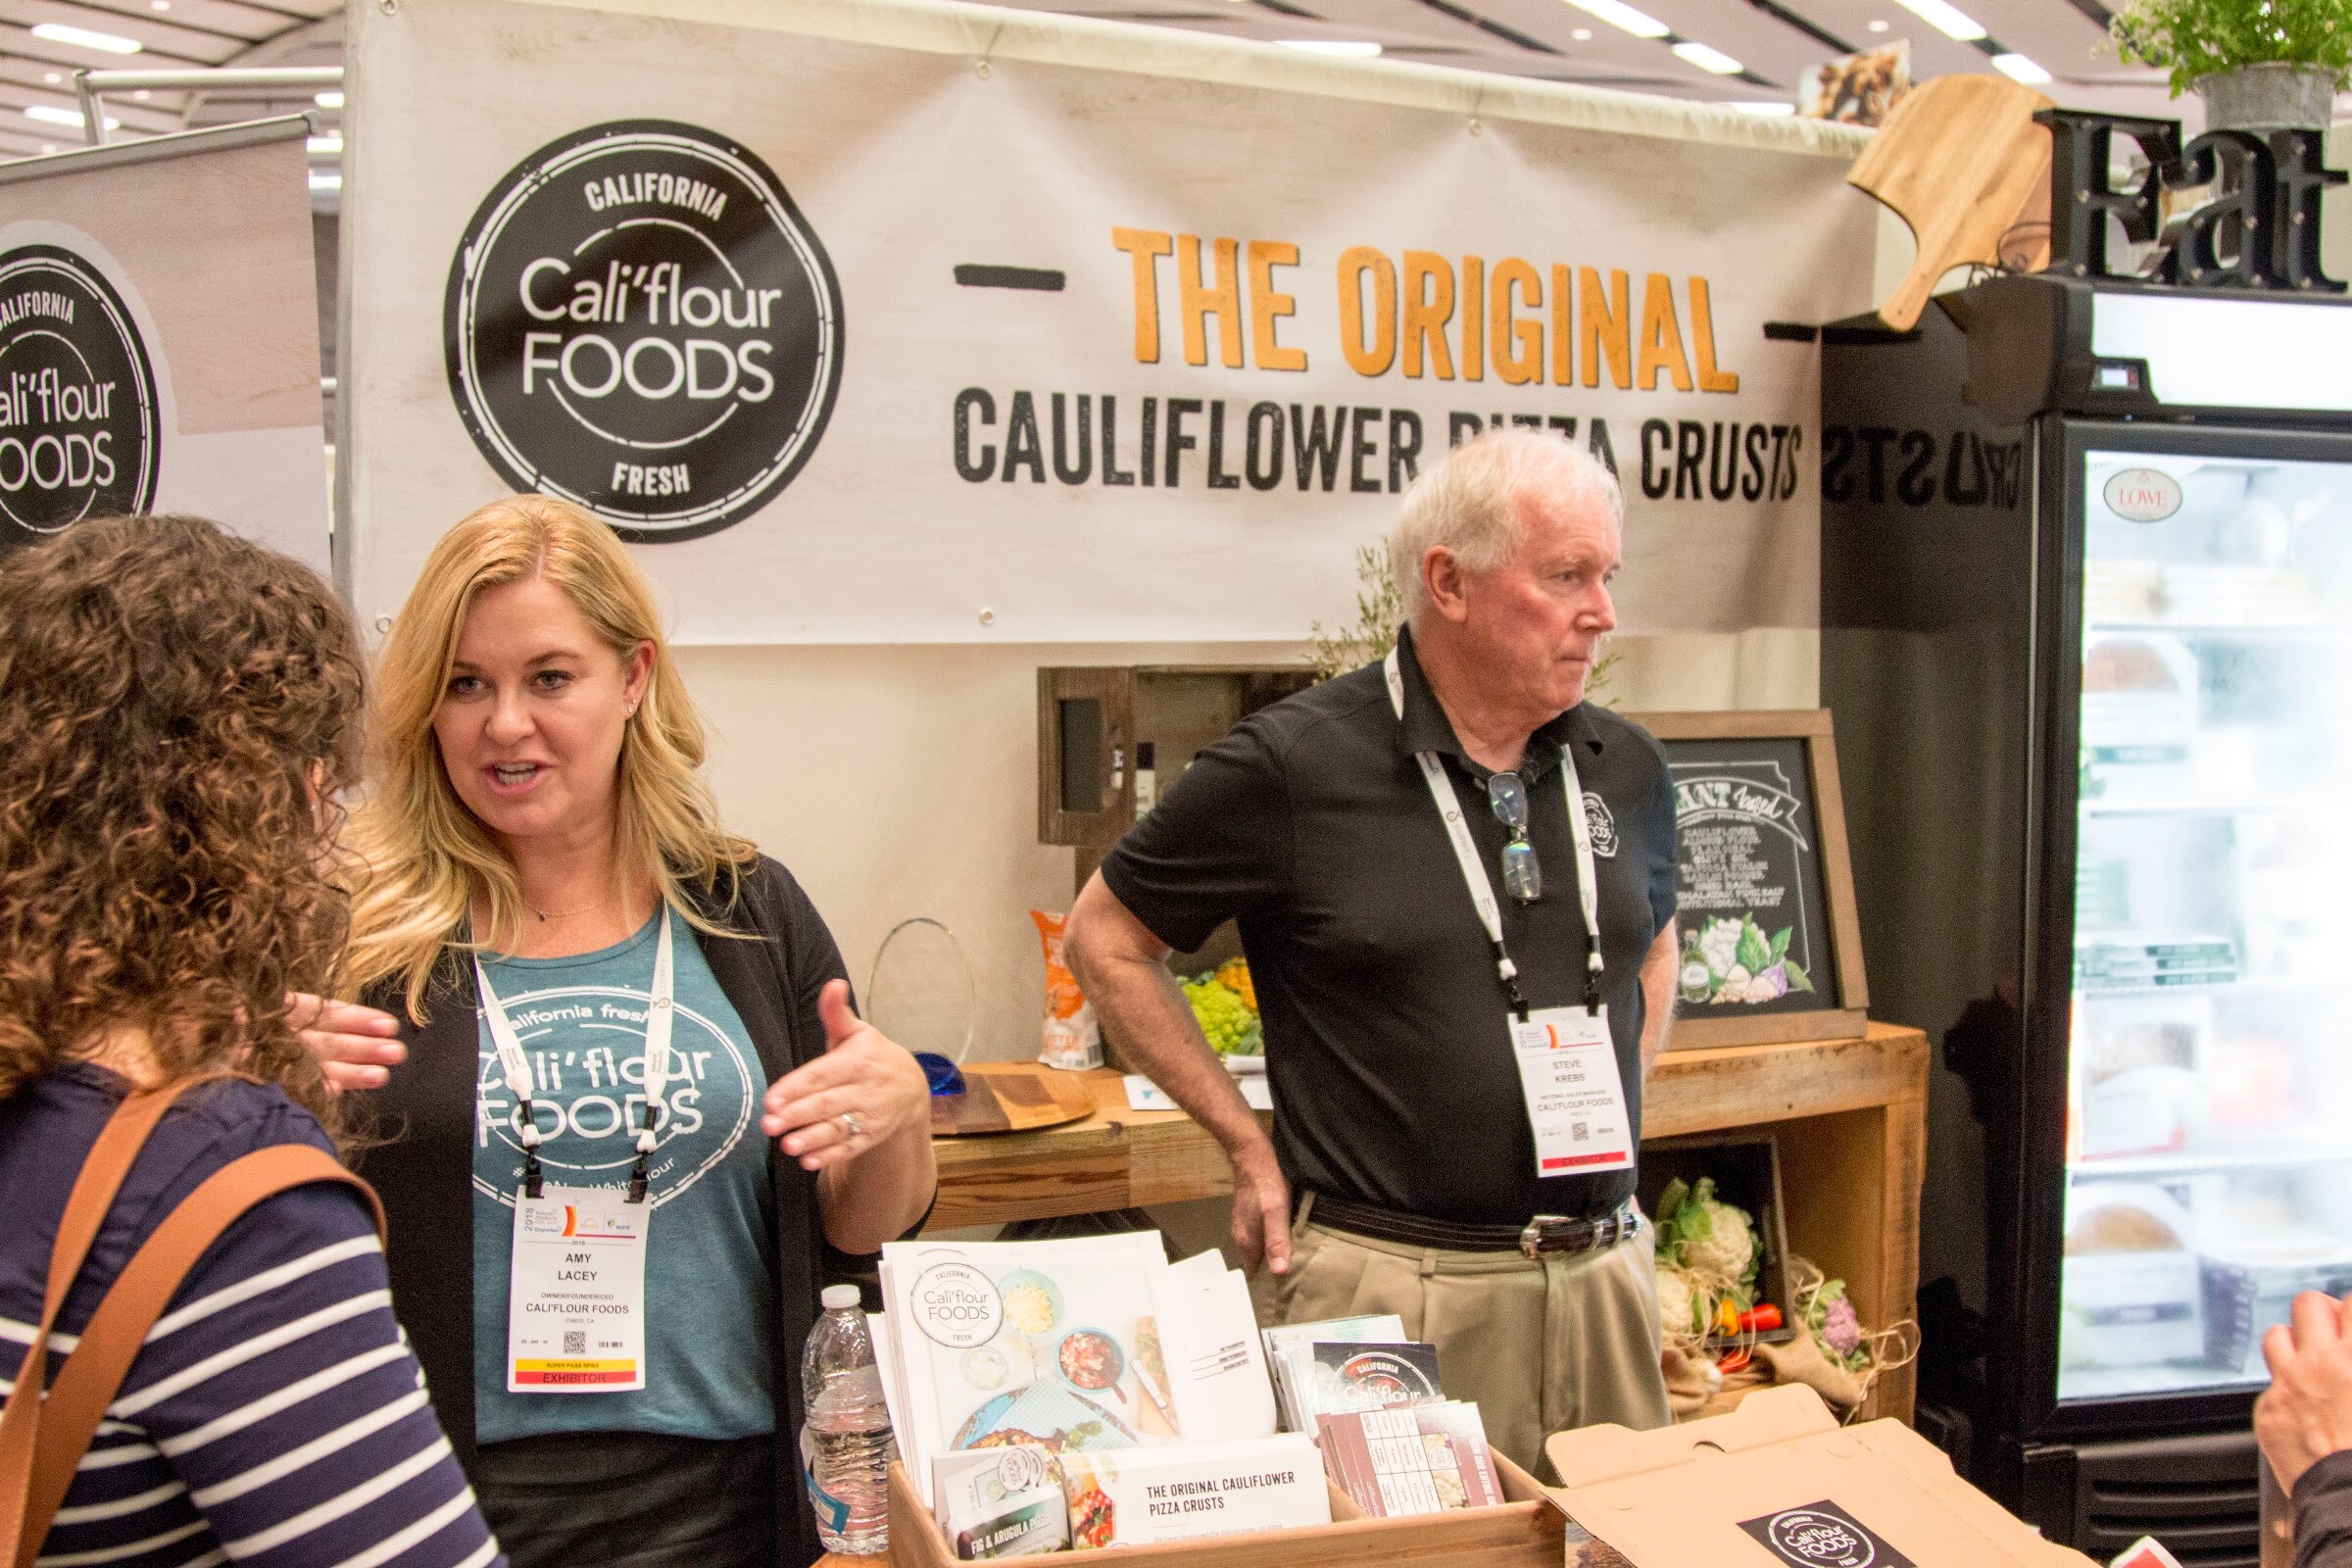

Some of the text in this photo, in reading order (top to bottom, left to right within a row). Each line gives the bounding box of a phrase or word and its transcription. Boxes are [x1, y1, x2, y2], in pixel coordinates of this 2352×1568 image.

[584, 172, 727, 220] CALIFORNIA
[2033, 107, 2349, 293] Eat
[519, 258, 782, 328] Cali'flour
[0, 291, 74, 330] ALIFORNIA
[1111, 225, 1740, 394] THE ORIGINAL
[522, 331, 774, 403] FOODS
[954, 386, 1423, 494] CAULIFLOWER
[1641, 417, 1803, 503] CRUSTS
[611, 463, 691, 496] FRESH
[510, 1004, 593, 1031] alifornia
[1552, 1059, 1582, 1070] STEVE
[1554, 1074, 1586, 1084] KREBS
[476, 1088, 704, 1149] FOODS
[524, 1207, 534, 1231] 2018
[565, 1253, 592, 1263] AMY
[558, 1271, 598, 1281] LACEY
[936, 1270, 970, 1280] CALIFORNIA
[525, 1303, 629, 1314] CALI'FLOUR FOODS
[924, 1289, 988, 1304] Cali'flour
[928, 1305, 990, 1320] FOODS
[543, 1373, 606, 1383] EXHIBITOR
[1356, 1361, 1399, 1375] CALIFORNIA
[1147, 1471, 1296, 1499] THE ORIGINAL CAULIFLOWER
[1150, 1496, 1225, 1516] PIZZA CRUSTS
[971, 1537, 984, 1554] FIG
[986, 1535, 993, 1548] &
[994, 1521, 1028, 1545] ARUGULA
[1798, 1534, 1858, 1558] FOODS
